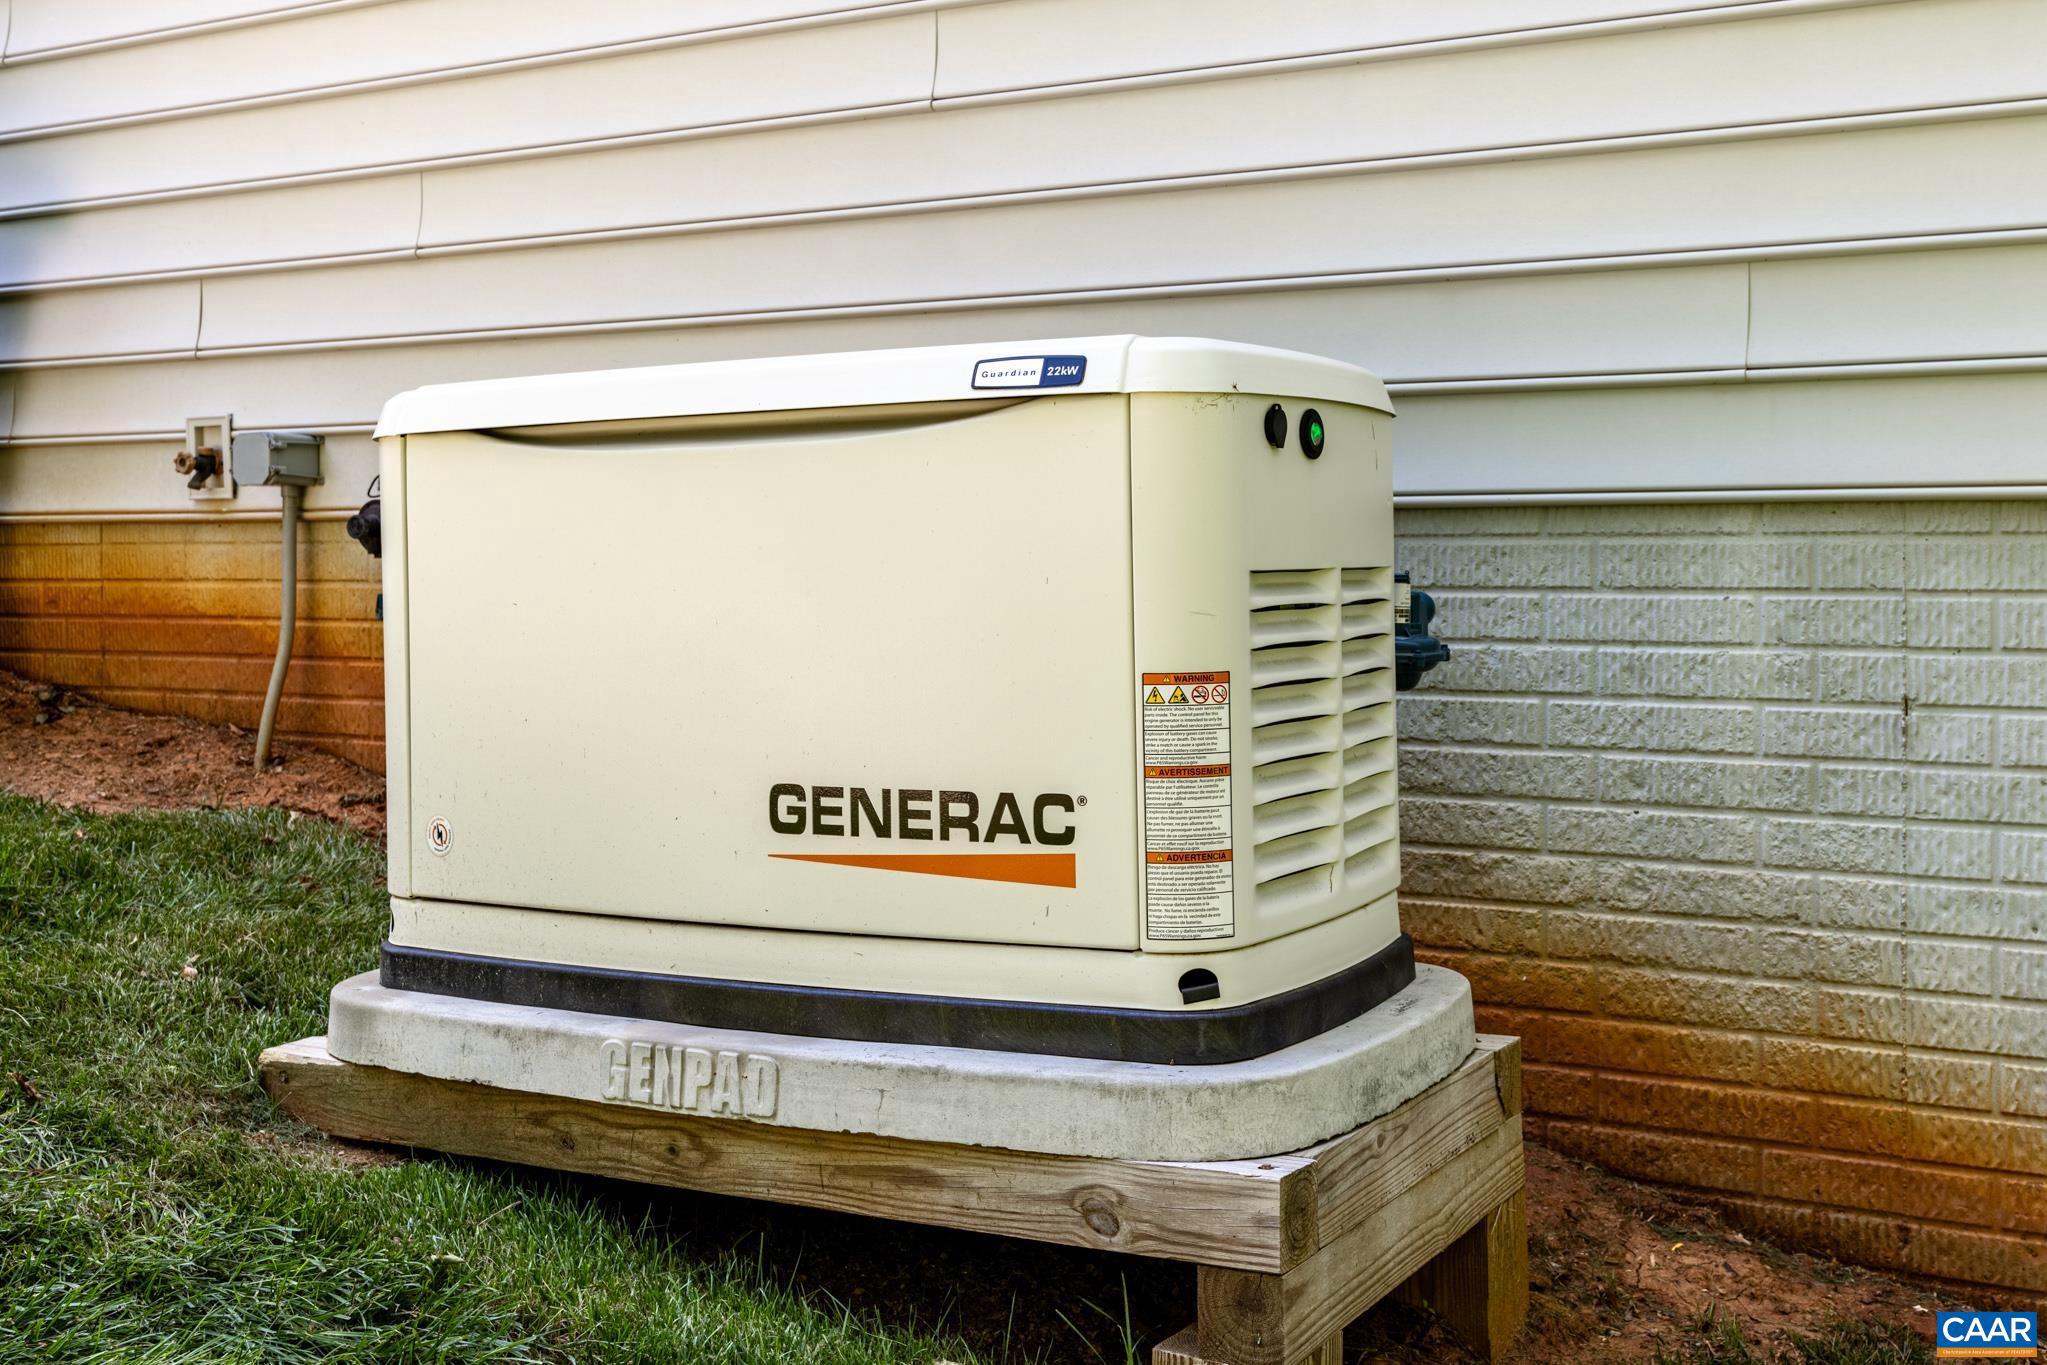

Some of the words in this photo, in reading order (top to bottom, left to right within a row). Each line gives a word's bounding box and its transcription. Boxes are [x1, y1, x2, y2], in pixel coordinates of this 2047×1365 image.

[981, 369, 1037, 379] Guardian
[1046, 365, 1079, 376] 22kW
[1174, 674, 1215, 682] WARNING
[1159, 767, 1228, 776] AVERTISSEMENT
[1167, 852, 1226, 862] ADVERTENCIA
[601, 1039, 779, 1119] GENPAD
